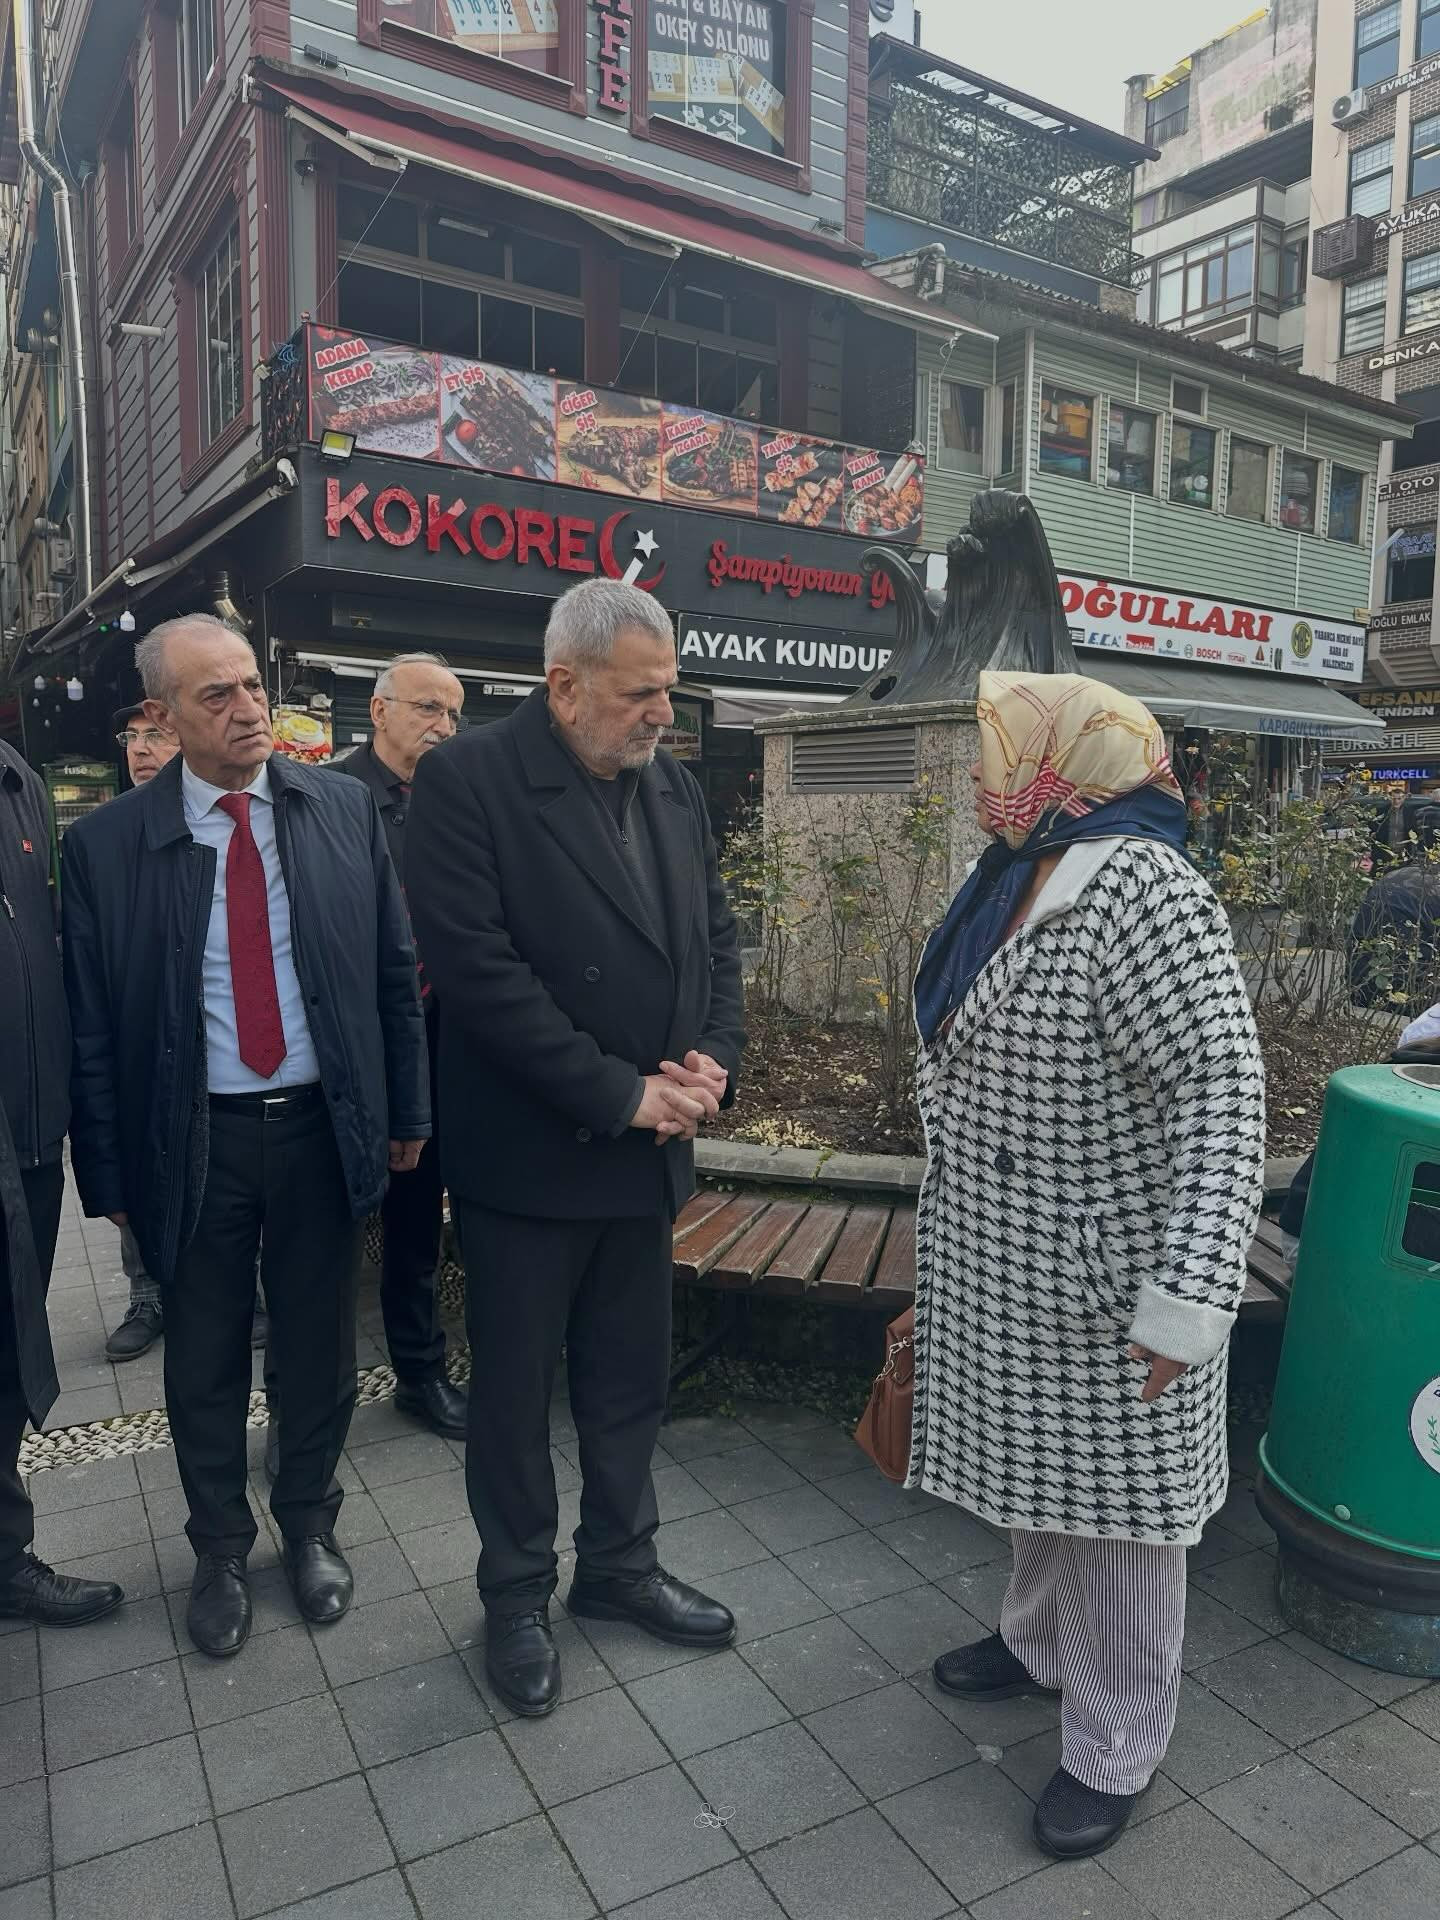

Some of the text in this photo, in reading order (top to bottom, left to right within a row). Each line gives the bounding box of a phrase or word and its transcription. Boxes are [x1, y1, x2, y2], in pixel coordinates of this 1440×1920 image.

[709, 0, 768, 31] BAYAN
[655, 12, 770, 61] OKEY SALONU
[1380, 59, 1440, 95] EVREN GO
[316, 339, 369, 368] ADANA
[326, 361, 374, 390] KEBAP
[445, 374, 460, 391] ET
[761, 434, 797, 459] TAVUK
[848, 450, 879, 475] TAVUK
[852, 467, 885, 494] KANAT
[1400, 477, 1435, 491] OTO
[708, 540, 863, 598] Şampiyonun
[1059, 580, 1273, 643] OĞULLARI
[1367, 611, 1431, 629] IOĞLU EMLAK
[680, 629, 767, 664] AYAK
[1196, 647, 1222, 660] BOSCH
[64, 765, 88, 775] fuse
[1372, 768, 1430, 779] TURKCELL
